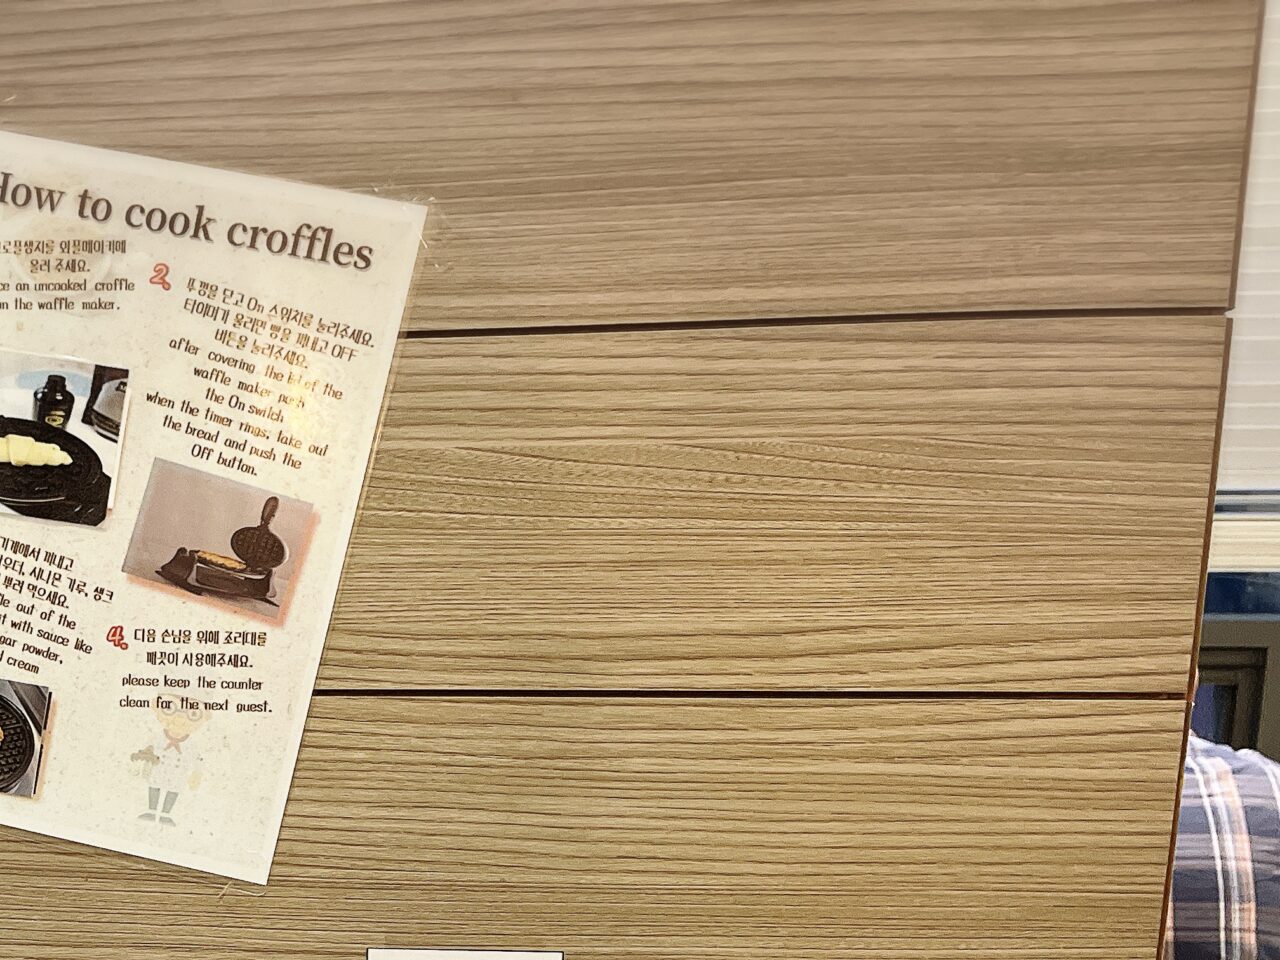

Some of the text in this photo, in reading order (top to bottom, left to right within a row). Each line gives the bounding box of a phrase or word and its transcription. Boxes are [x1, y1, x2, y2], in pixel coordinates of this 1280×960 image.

[78, 189, 112, 222] to
[125, 205, 216, 242] cook
[227, 221, 375, 270] croffles
[16, 283, 29, 291] an
[35, 279, 86, 291] uncooked
[95, 279, 135, 291] croffle
[149, 263, 171, 291] 2.
[15, 298, 32, 310] the
[38, 298, 74, 310] waffle
[82, 298, 120, 310] maker.
[247, 297, 264, 313] On
[331, 344, 359, 362] OFF
[169, 337, 201, 356] after
[208, 351, 256, 374] covering
[264, 365, 284, 382] the
[323, 383, 343, 400] the
[193, 366, 231, 387] waffle
[205, 388, 284, 423] the On switch
[146, 391, 175, 409] when
[180, 399, 199, 417] the
[205, 407, 232, 427] timer
[277, 430, 302, 449] take
[309, 443, 329, 457] out
[163, 415, 302, 469] the bread and push the
[191, 444, 257, 476] Off button.
[16, 603, 35, 616] out
[40, 609, 55, 621] of
[59, 614, 76, 630] the
[10, 618, 33, 635] with
[37, 628, 69, 646] sauce
[74, 638, 93, 654] like
[106, 626, 128, 650] 4.
[7, 655, 39, 674] cream
[22, 642, 63, 664] powder,
[122, 674, 264, 690] please keep the counter
[120, 695, 272, 713] clean for the next guest.
